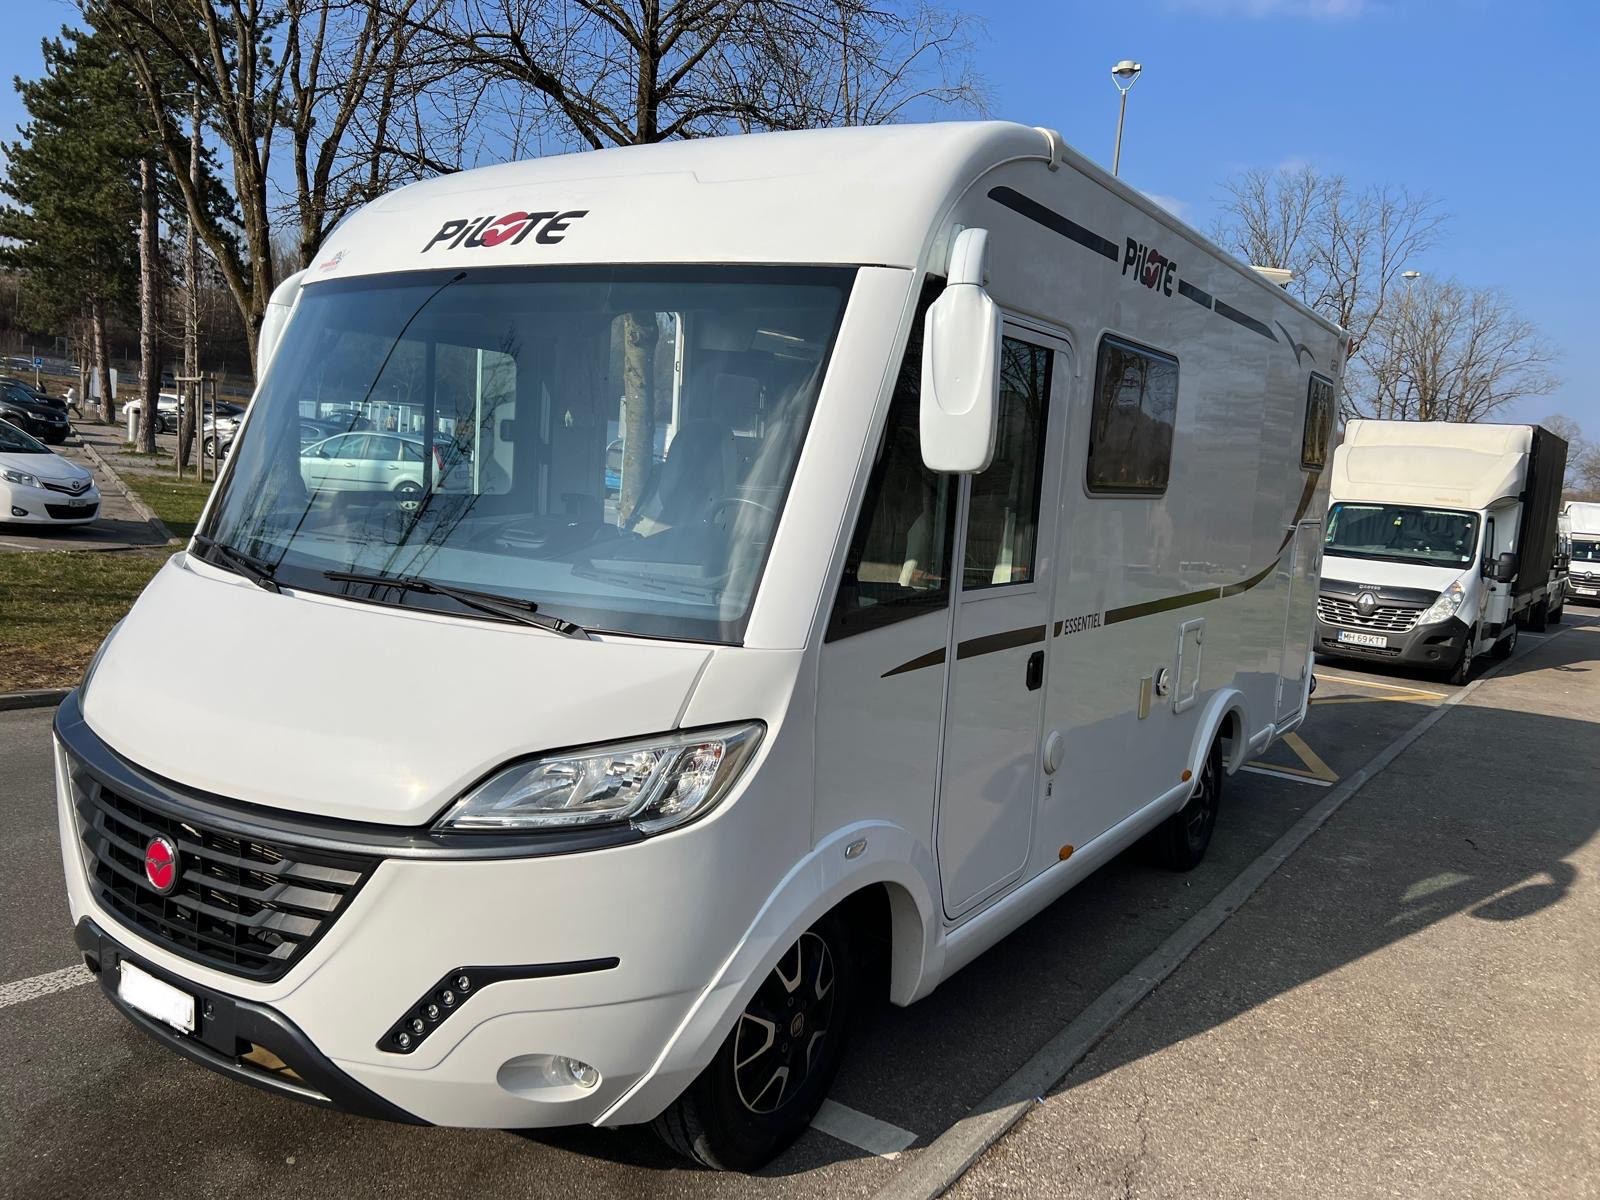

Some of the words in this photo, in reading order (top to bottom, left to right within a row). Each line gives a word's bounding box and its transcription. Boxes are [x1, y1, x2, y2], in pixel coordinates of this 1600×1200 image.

[1064, 612, 1102, 635] ESSENTIEL
[1358, 634, 1368, 642] 69
[1369, 636, 1384, 645] KTT
